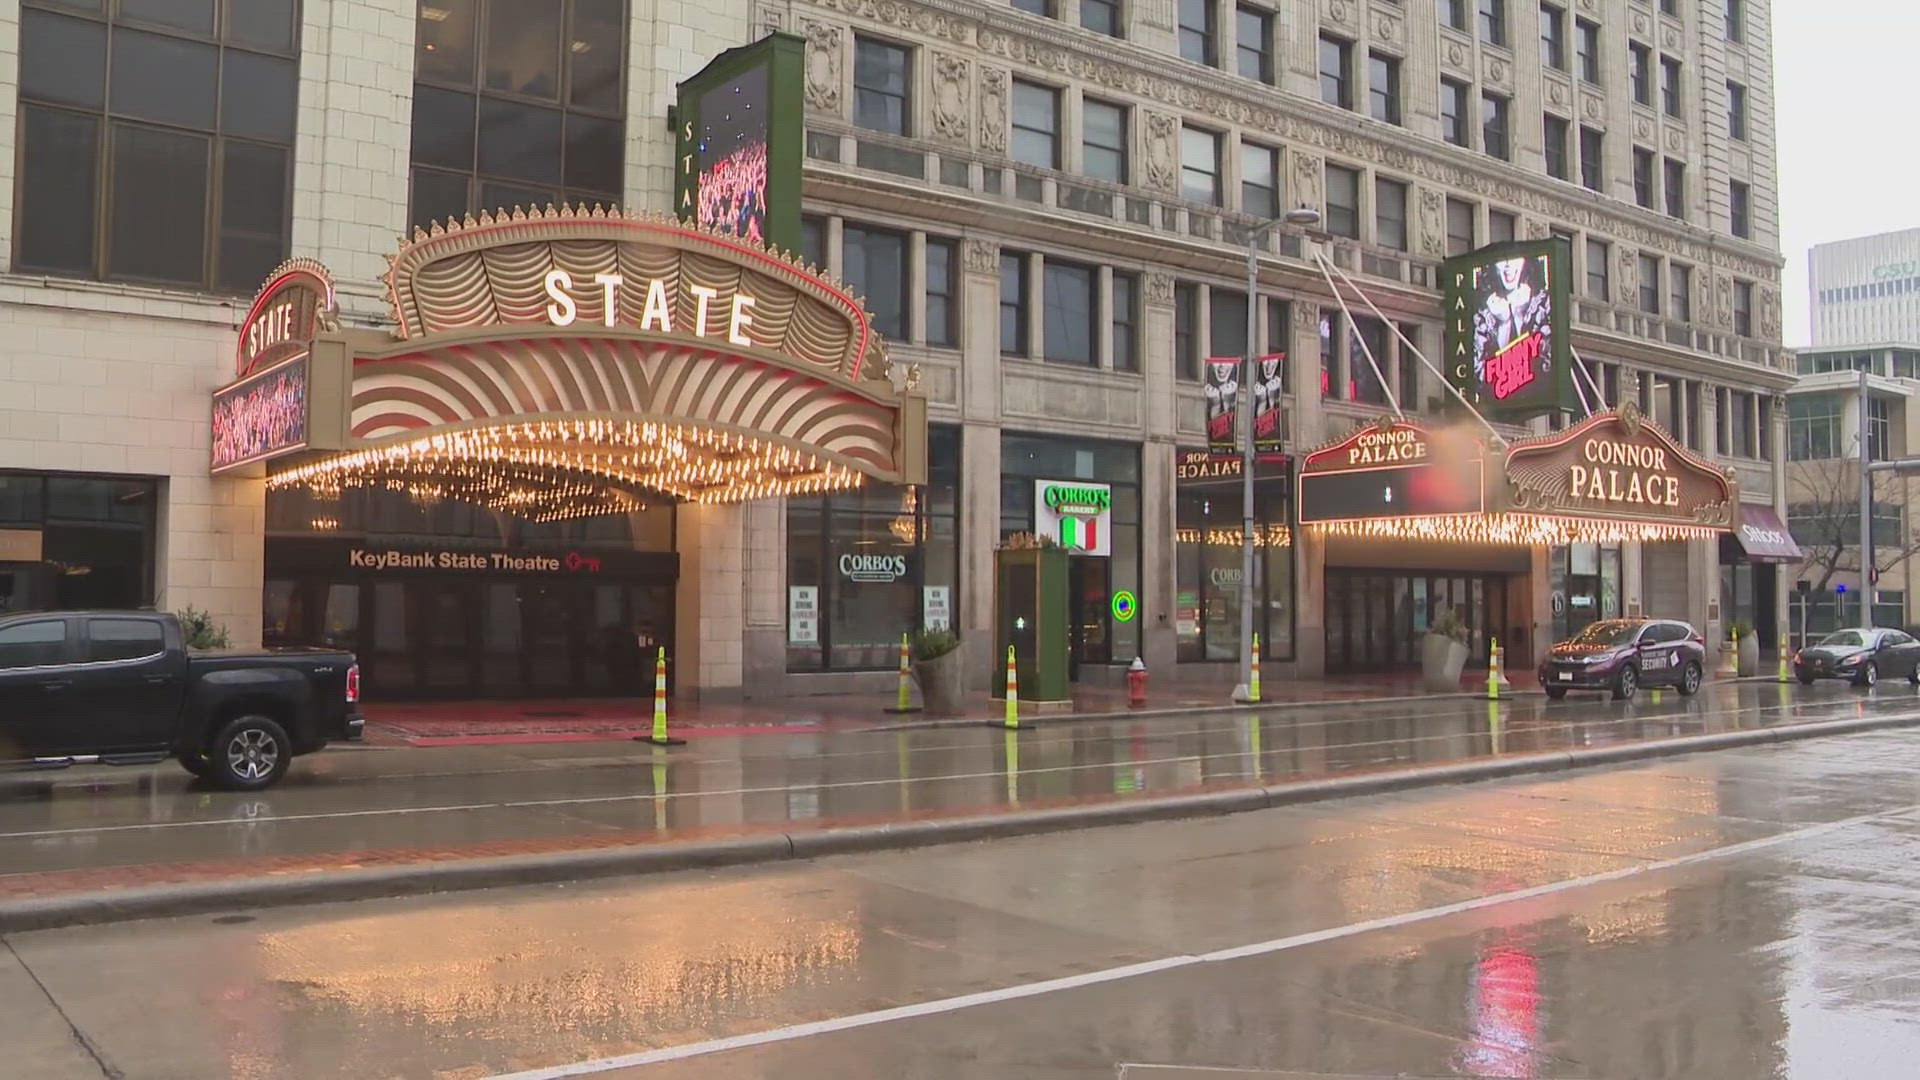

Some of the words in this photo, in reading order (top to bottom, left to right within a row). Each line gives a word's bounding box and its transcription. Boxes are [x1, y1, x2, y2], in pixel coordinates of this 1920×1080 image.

[544, 269, 756, 347] STATE
[249, 302, 293, 360] STATE
[1486, 332, 1542, 384] FUNNY
[1494, 369, 1534, 399] GIRL
[1357, 430, 1416, 448] CONNOR
[1349, 443, 1427, 464] PALACE
[1585, 439, 1667, 471] CONNOR
[1570, 465, 1680, 506] PALACE
[1044, 485, 1111, 511] CORBO'S
[1063, 505, 1095, 513] BAKERY
[350, 550, 435, 569] KeyBank
[439, 552, 488, 568] State
[492, 553, 560, 570] Theatre
[839, 554, 906, 576] CORBO'S
[1211, 567, 1243, 585] CORB
[1641, 657, 1667, 670] SECURITY
